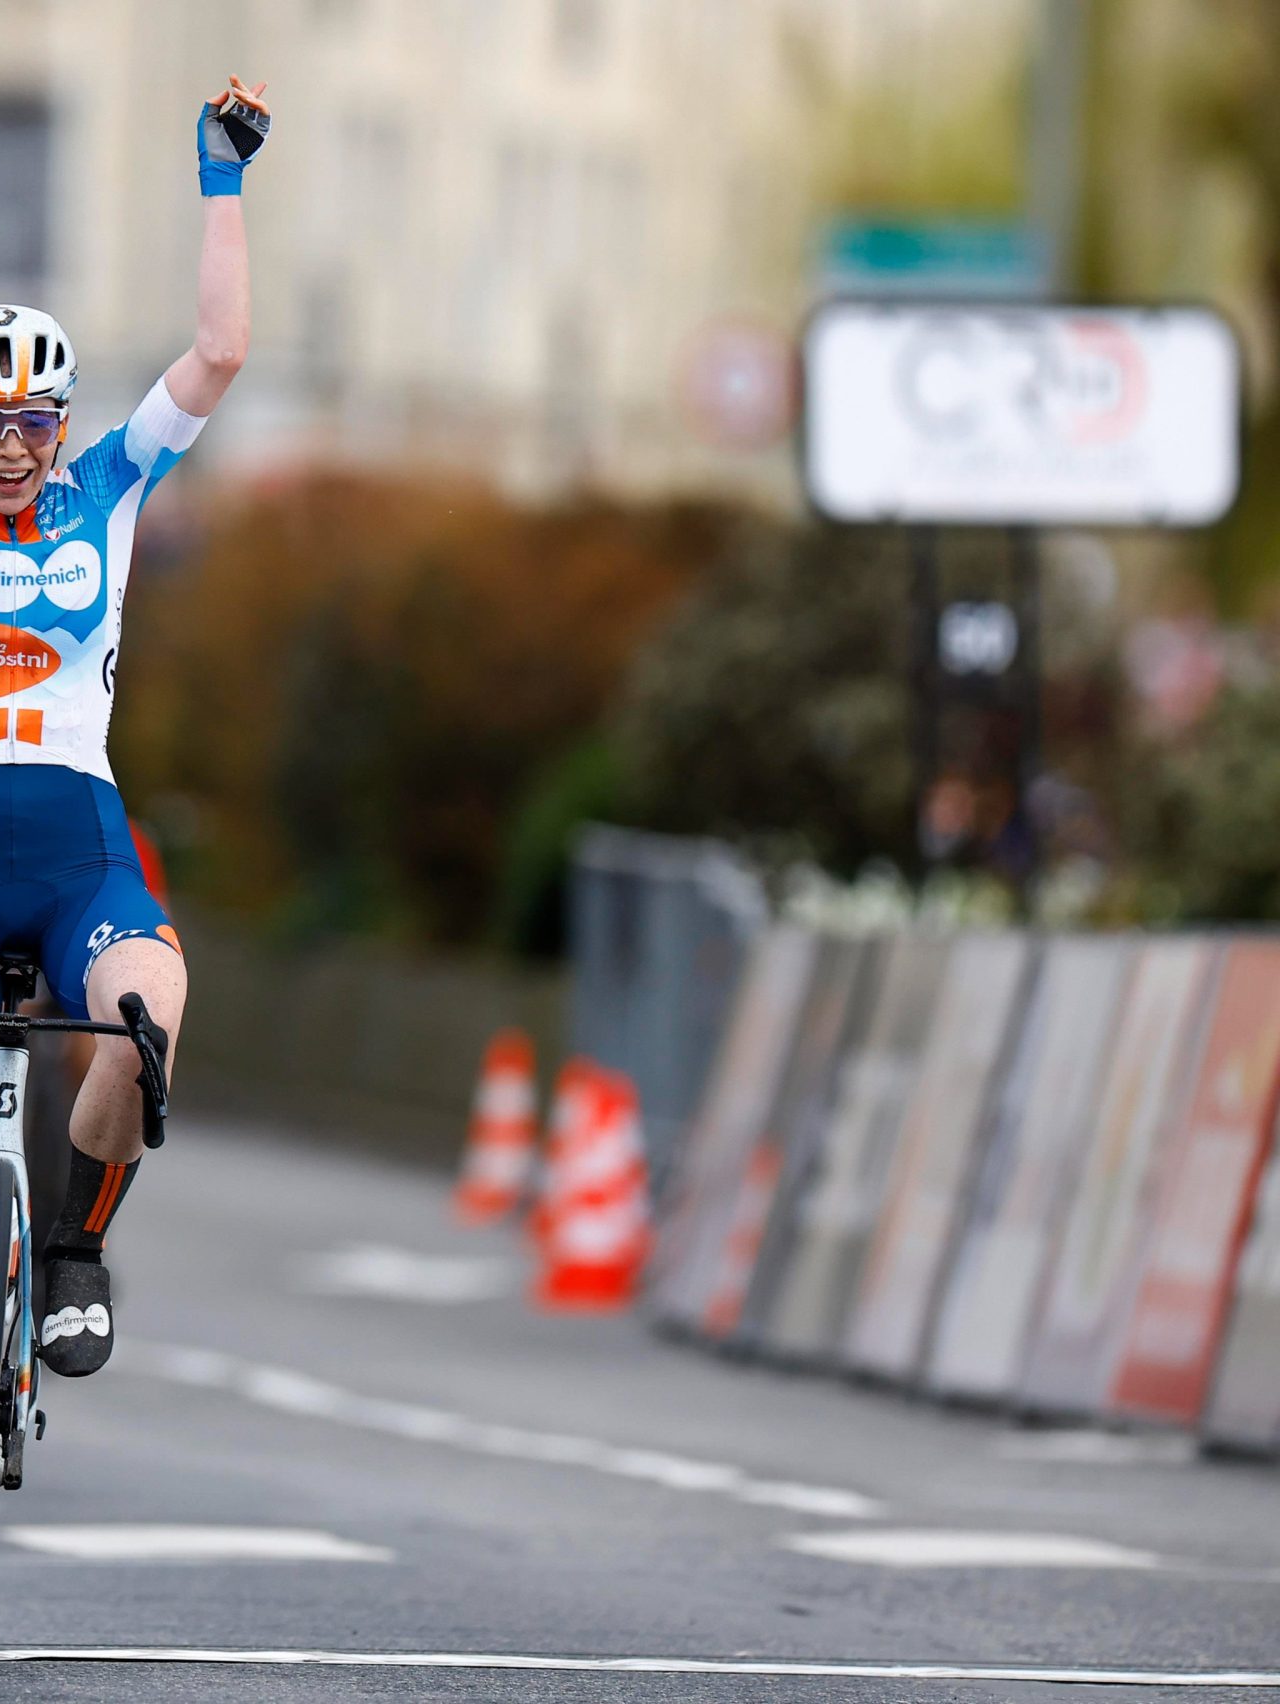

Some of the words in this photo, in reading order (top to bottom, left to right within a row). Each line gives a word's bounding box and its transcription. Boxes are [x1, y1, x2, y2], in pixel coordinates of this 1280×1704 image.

[59, 512, 84, 535] Nalini
[0, 1020, 28, 1028] wahoo
[45, 1315, 104, 1334] dsm-firmenich
